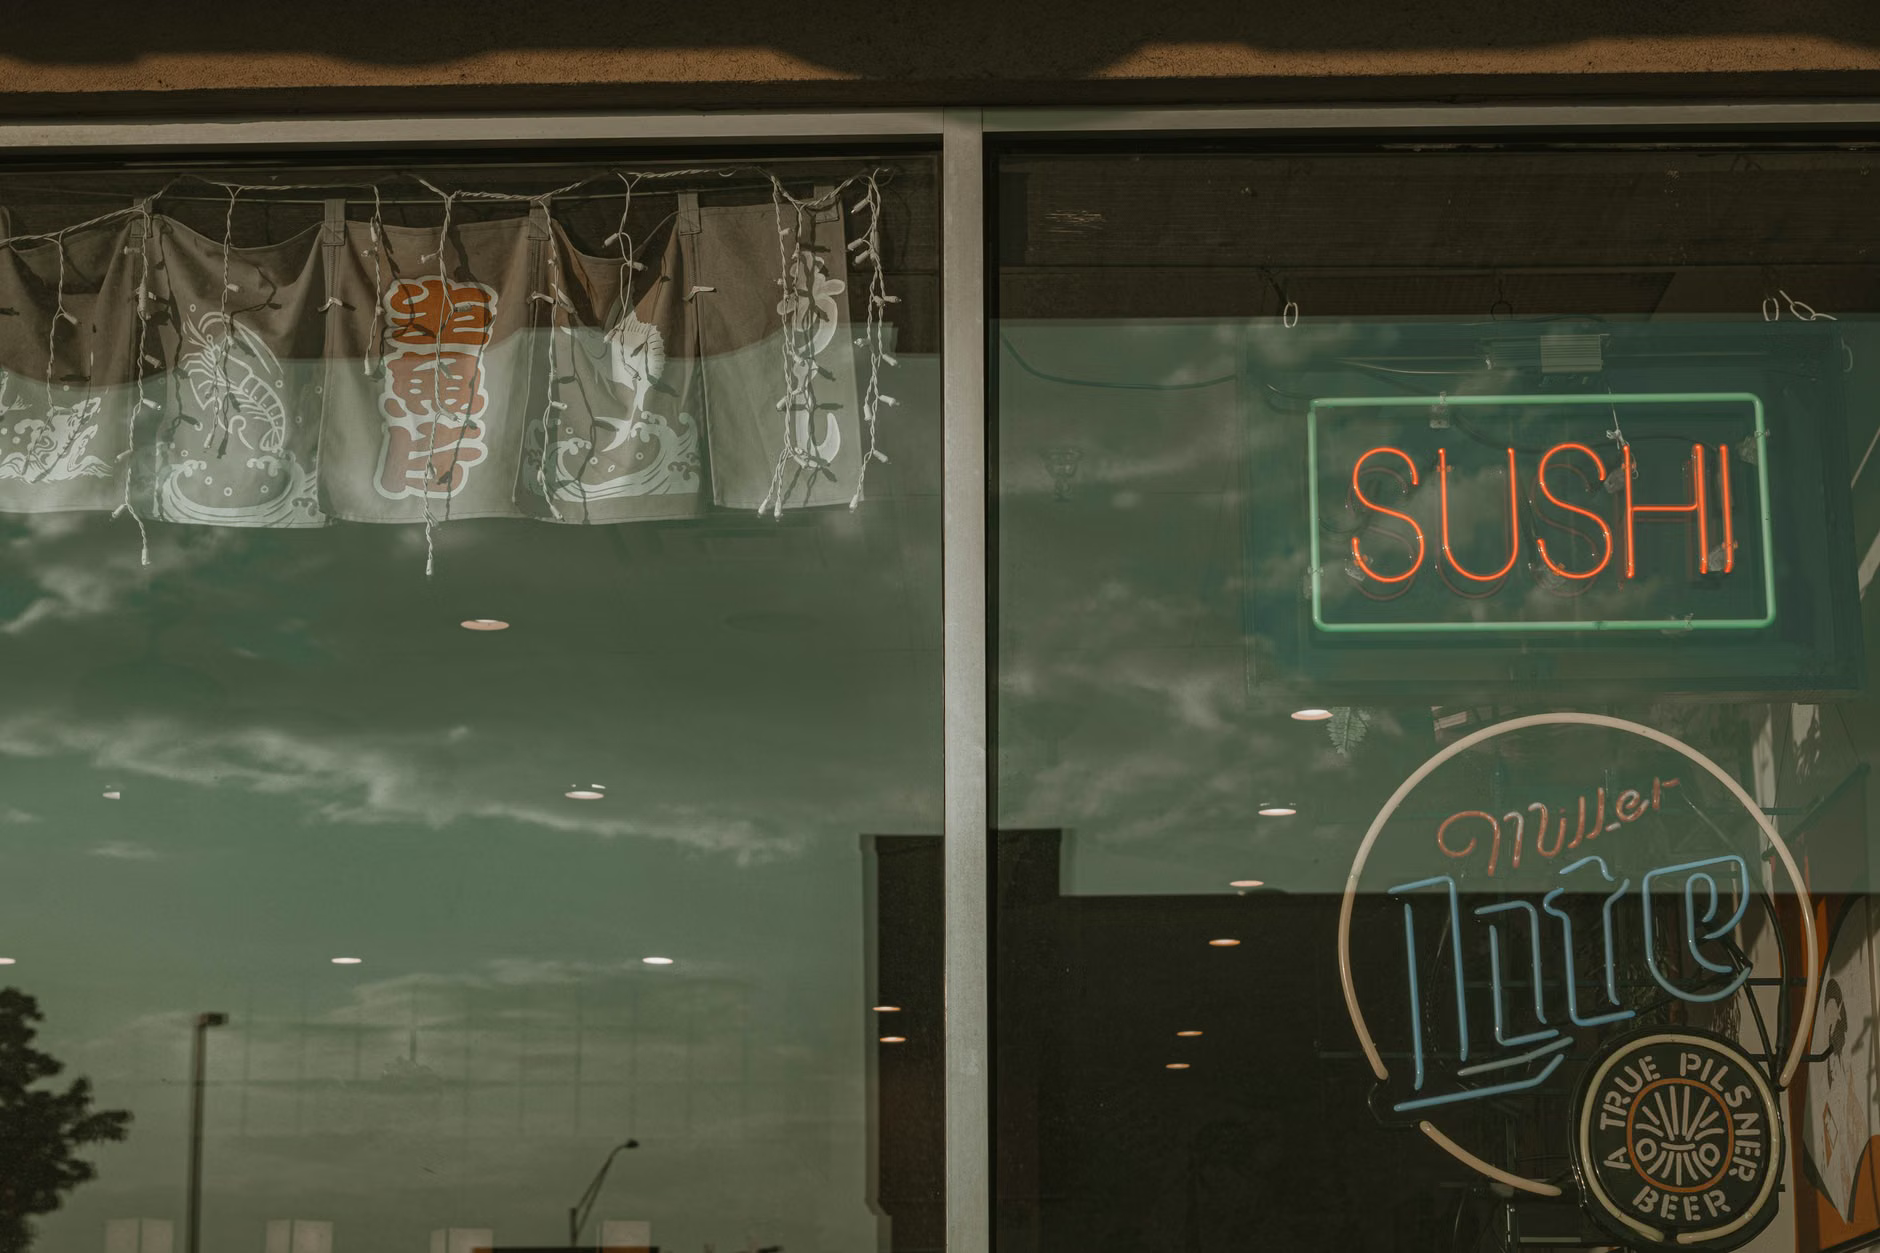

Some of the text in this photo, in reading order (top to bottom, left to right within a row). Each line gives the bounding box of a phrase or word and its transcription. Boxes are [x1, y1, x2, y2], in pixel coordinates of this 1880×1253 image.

[1351, 442, 1736, 583] SUSHI
[1437, 776, 1680, 877] Miller
[1388, 855, 1752, 1112] Lite
[1600, 1052, 1761, 1182] A TRUE PILSNER
[1632, 1185, 1732, 1221] BEER
